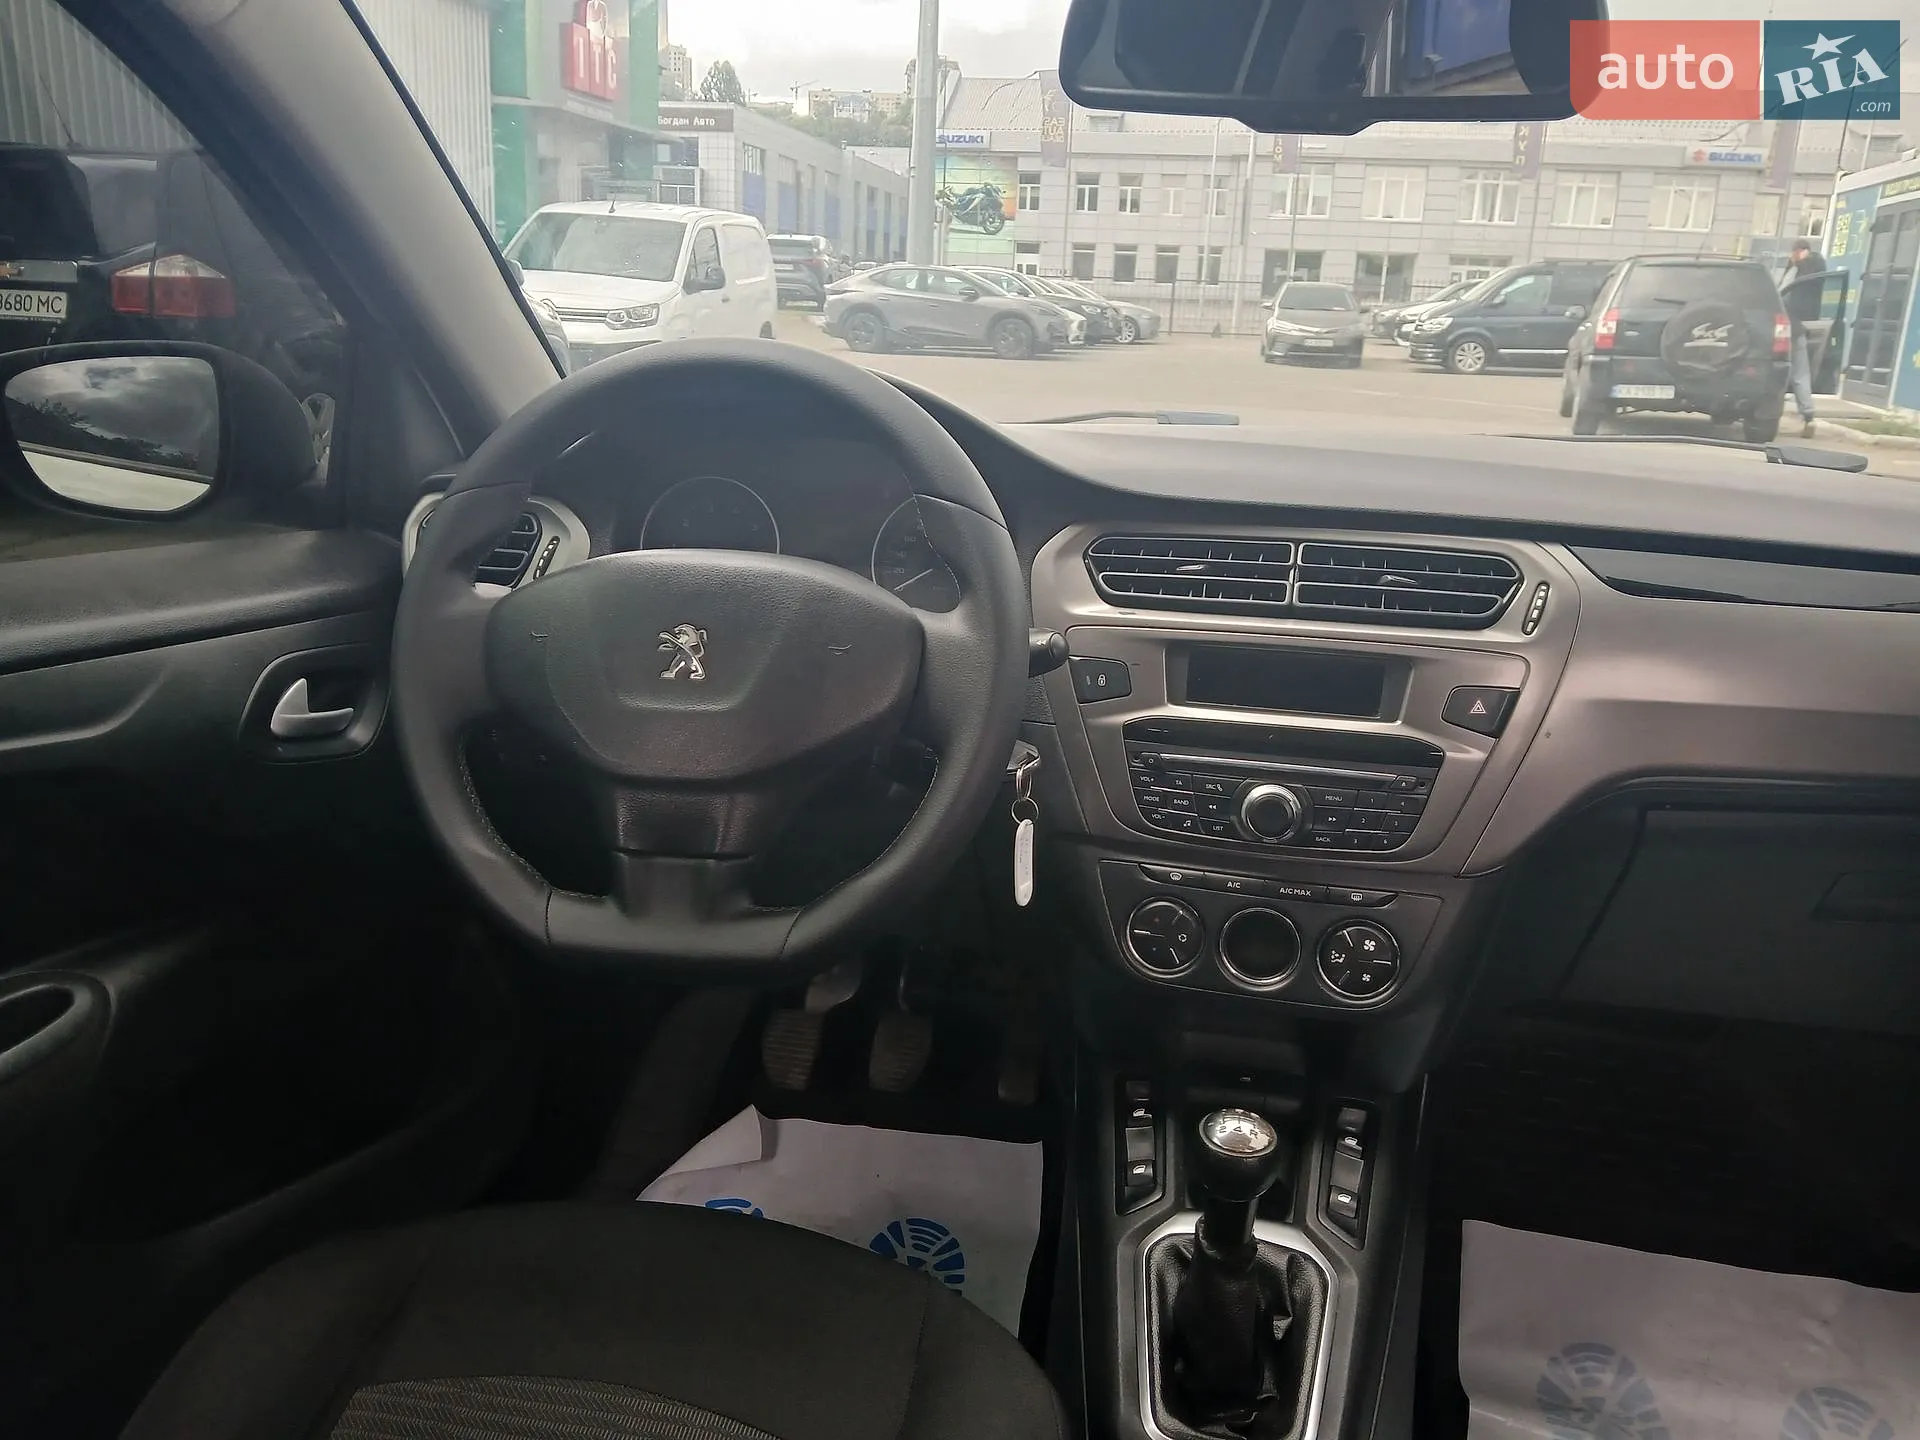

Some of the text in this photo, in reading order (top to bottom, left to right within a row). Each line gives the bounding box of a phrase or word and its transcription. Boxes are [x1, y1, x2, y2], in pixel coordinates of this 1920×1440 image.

[658, 116, 715, 126] Богдан Авто
[938, 134, 984, 144] SUZUKI
[1709, 151, 1762, 163] SUZUKI
[0, 292, 62, 313] 680 MC
[1227, 881, 1241, 889] A/C
[1294, 888, 1312, 897] MAX
